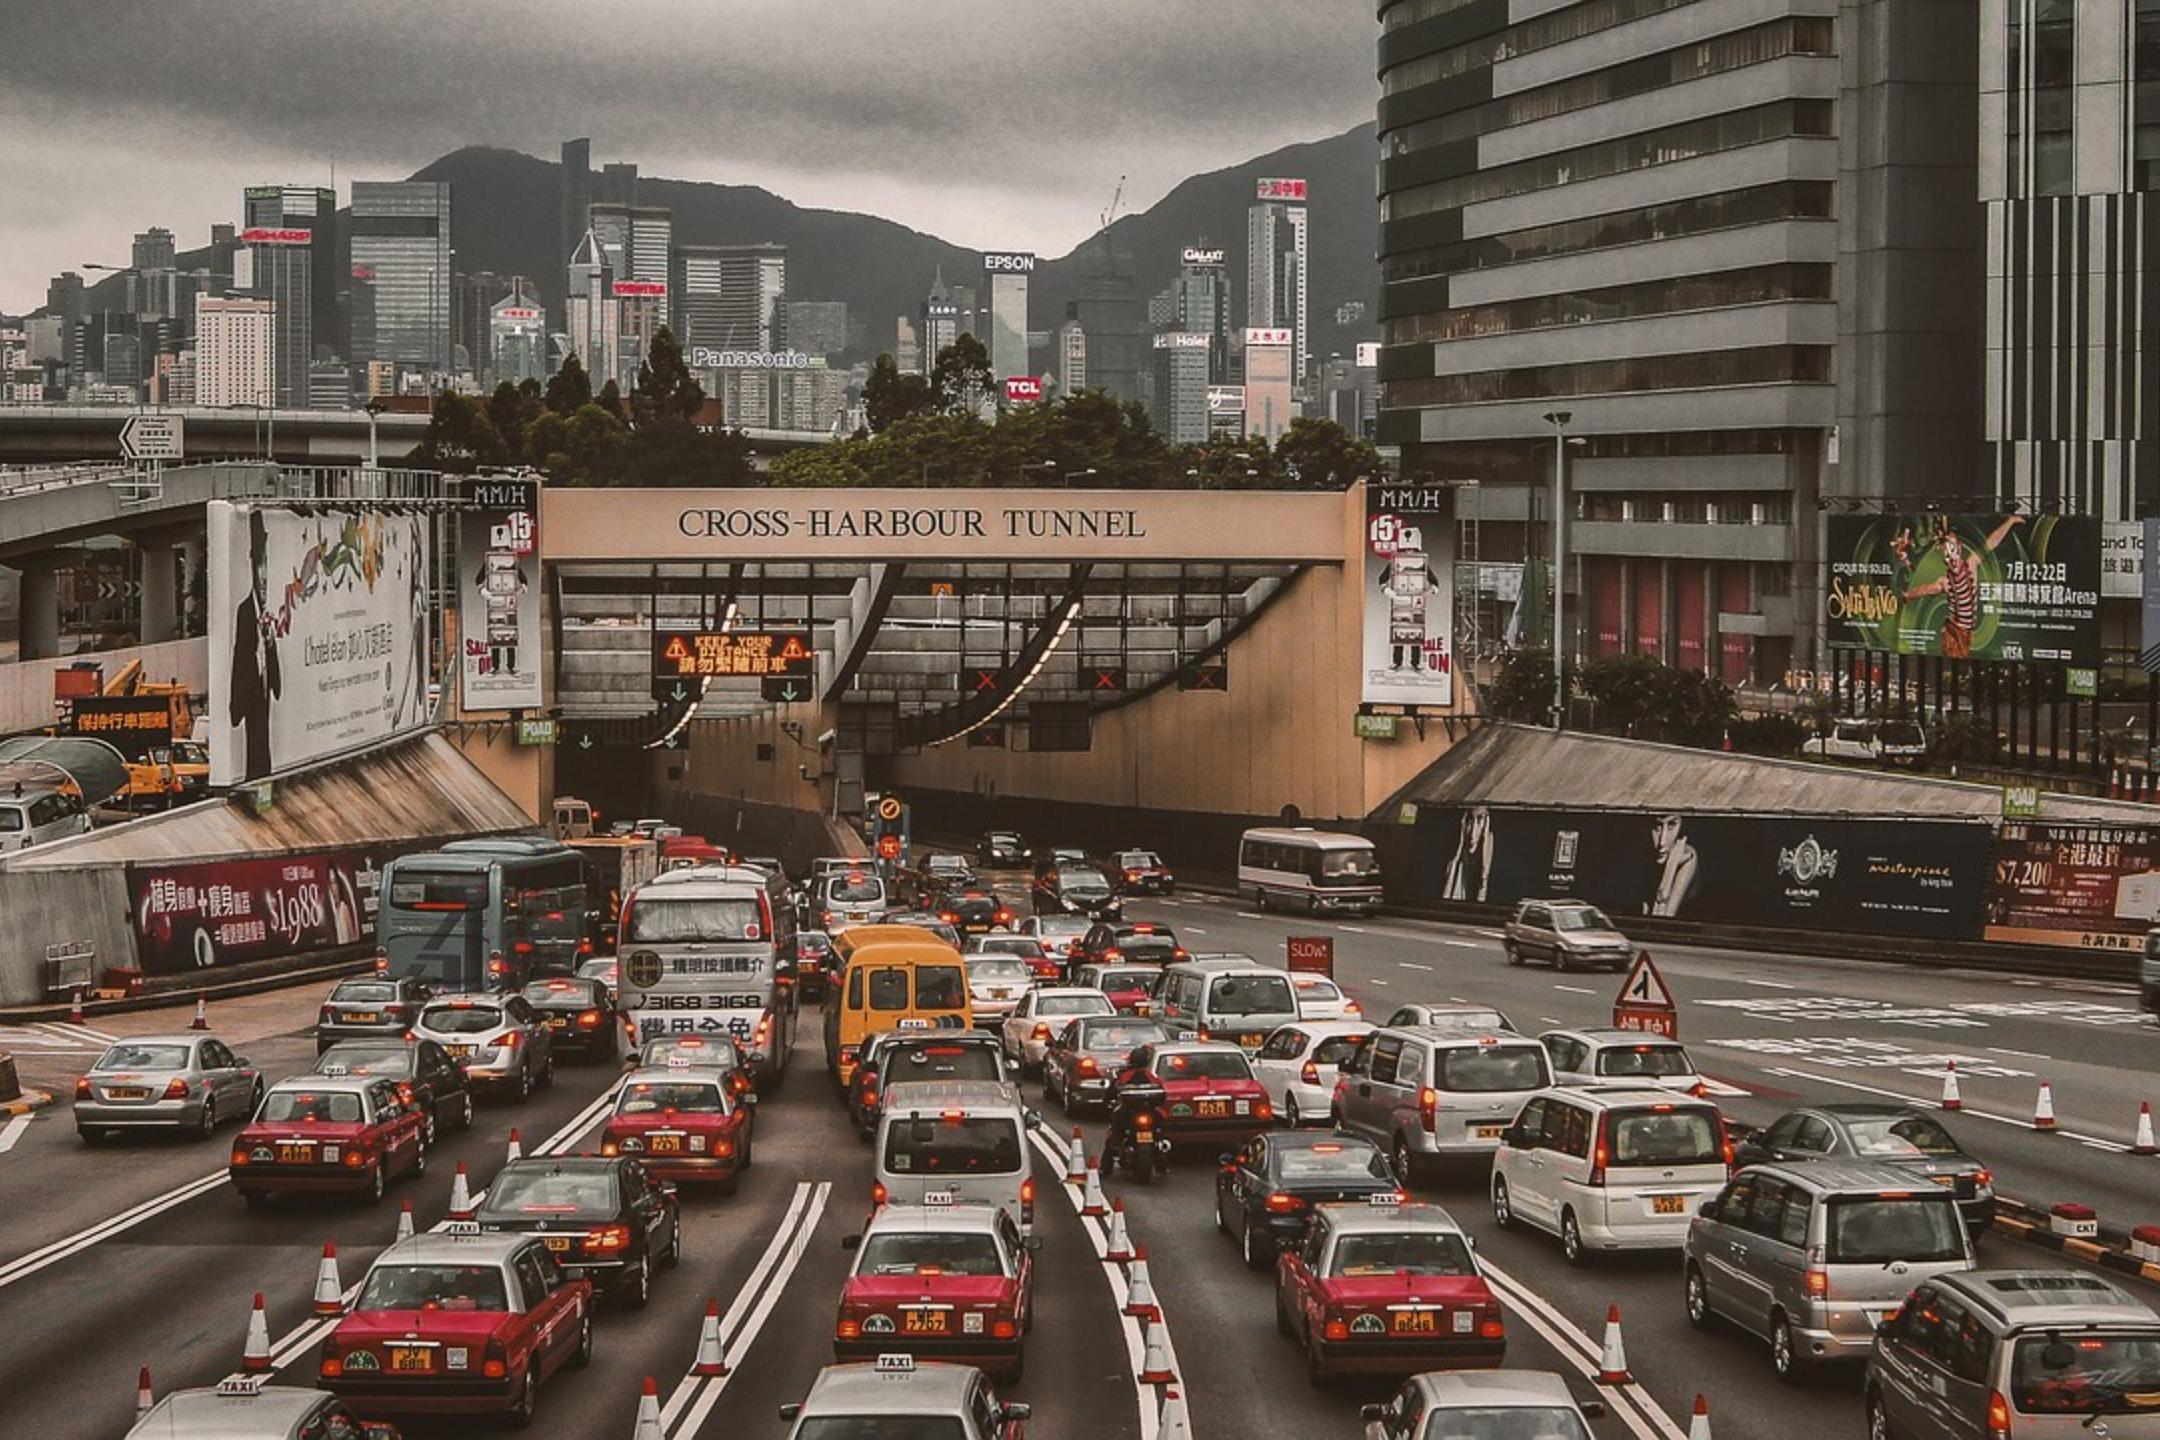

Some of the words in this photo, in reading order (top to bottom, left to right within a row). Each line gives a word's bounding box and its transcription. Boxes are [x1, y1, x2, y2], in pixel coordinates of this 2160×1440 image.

[985, 255, 1034, 270] EPSON
[692, 347, 808, 368] Panasonic
[1007, 382, 1039, 393] TCL
[679, 510, 986, 537] CROSS-HARBOUR
[1003, 510, 1146, 537] TUNNEL
[694, 636, 730, 647] KEEP
[738, 636, 772, 647] YOUR
[700, 645, 768, 657] DISTANCE
[2002, 647, 2023, 660] VISA
[678, 656, 787, 673] 請勿緊隨前車
[265, 883, 321, 945] $1,988
[650, 996, 701, 1010] 3168
[709, 995, 761, 1010] 3168
[927, 1195, 950, 1203] TAXI
[452, 1223, 478, 1233] TAXI
[881, 1356, 910, 1367] TAXI
[224, 1382, 253, 1392] TAXI
